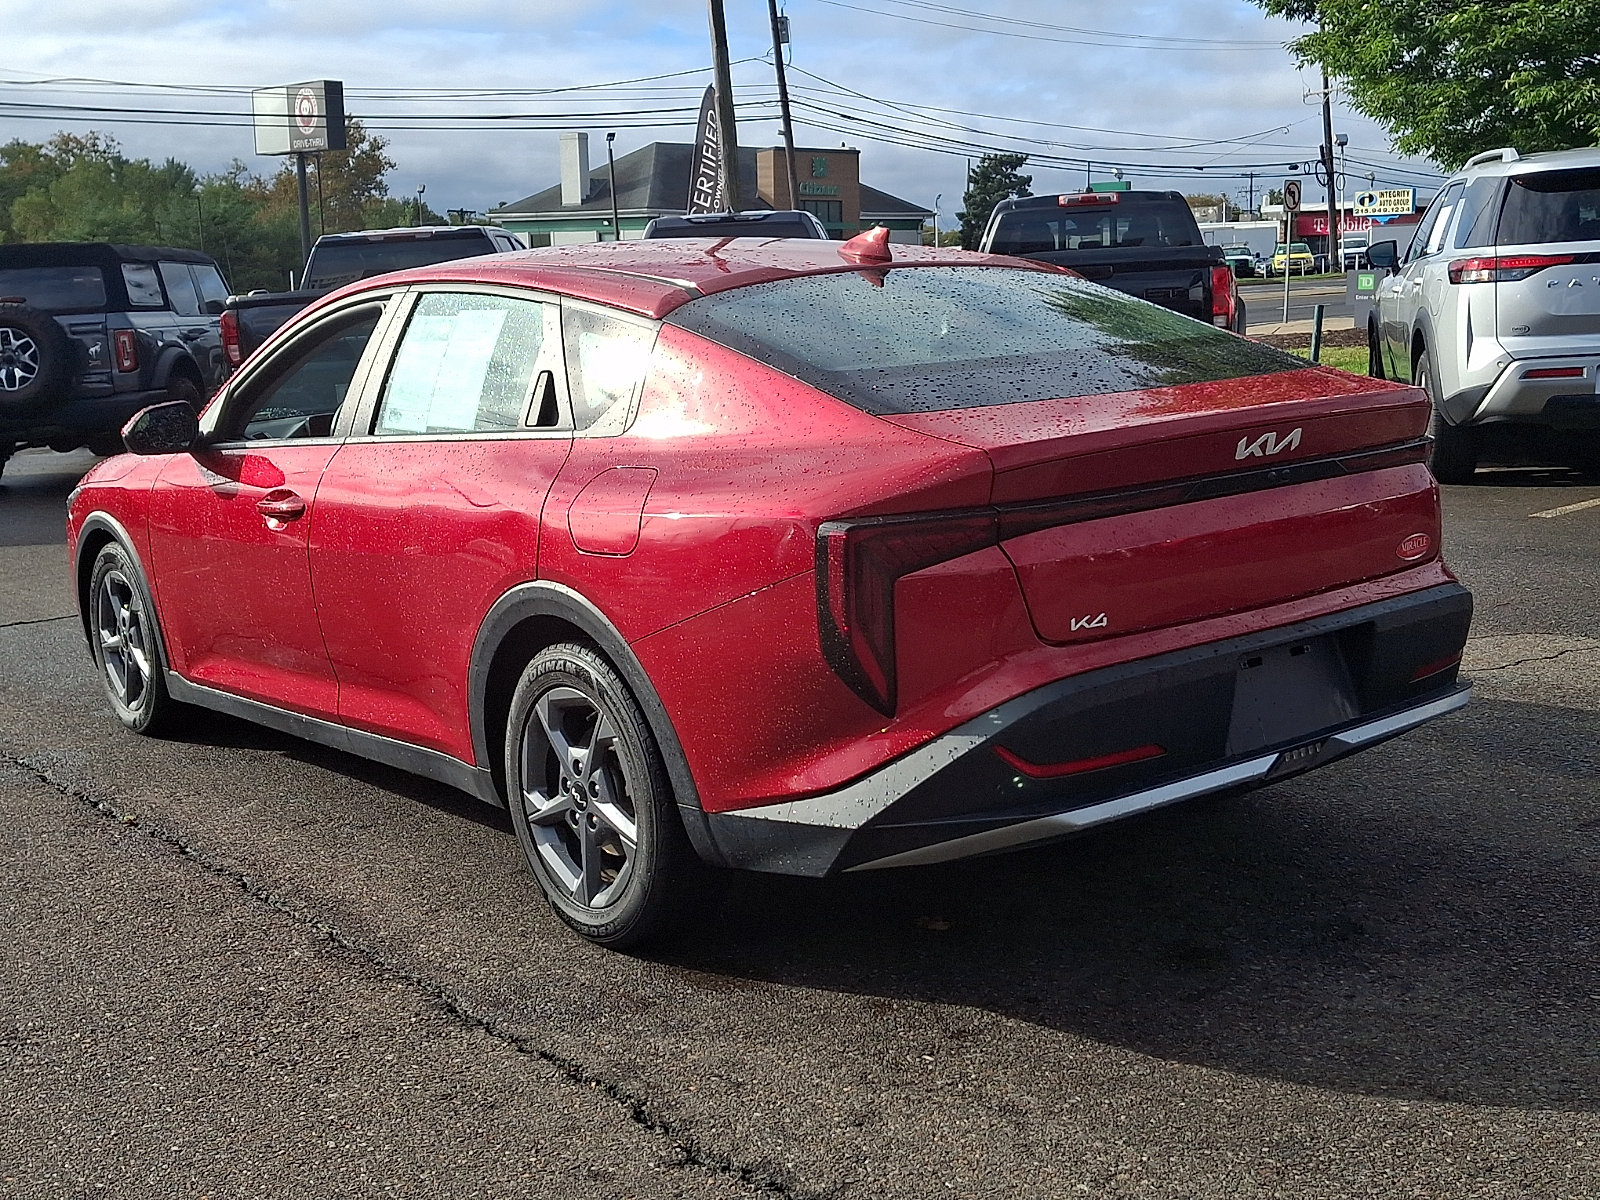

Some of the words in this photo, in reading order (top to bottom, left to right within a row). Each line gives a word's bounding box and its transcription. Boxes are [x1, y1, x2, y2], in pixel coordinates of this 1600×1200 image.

[293, 138, 325, 149] DRIVE-THRU
[1378, 190, 1411, 198] INTEGRITY
[1379, 199, 1392, 207] AUTO
[1393, 198, 1410, 206] GROUP
[1235, 428, 1302, 460] KIA
[1071, 612, 1107, 631] K4
